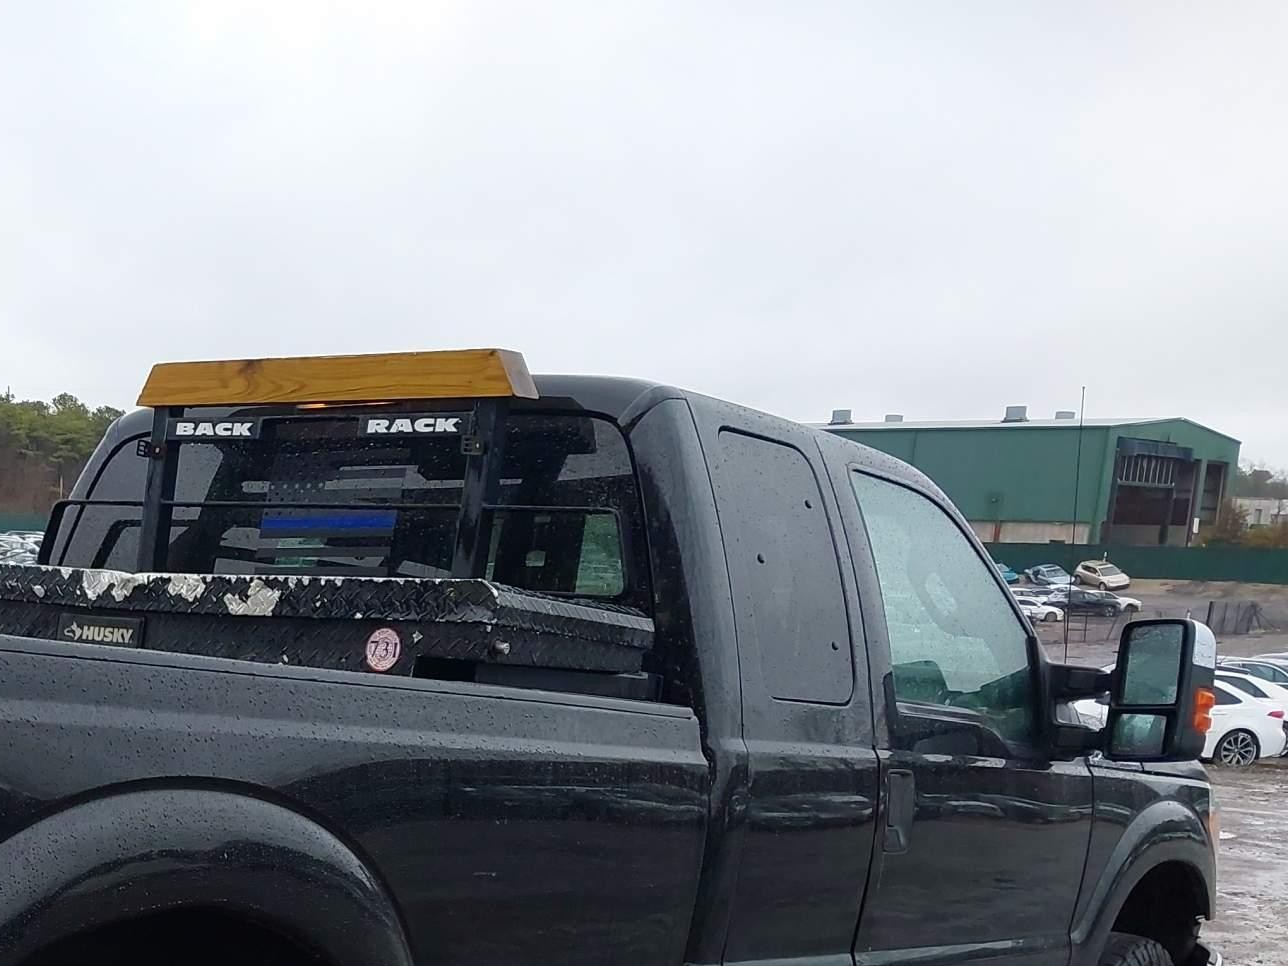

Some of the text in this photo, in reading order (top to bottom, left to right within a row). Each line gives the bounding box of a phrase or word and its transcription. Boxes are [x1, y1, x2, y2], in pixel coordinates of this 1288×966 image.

[176, 417, 458, 437] BACK RACK
[81, 625, 134, 644] HUSKY
